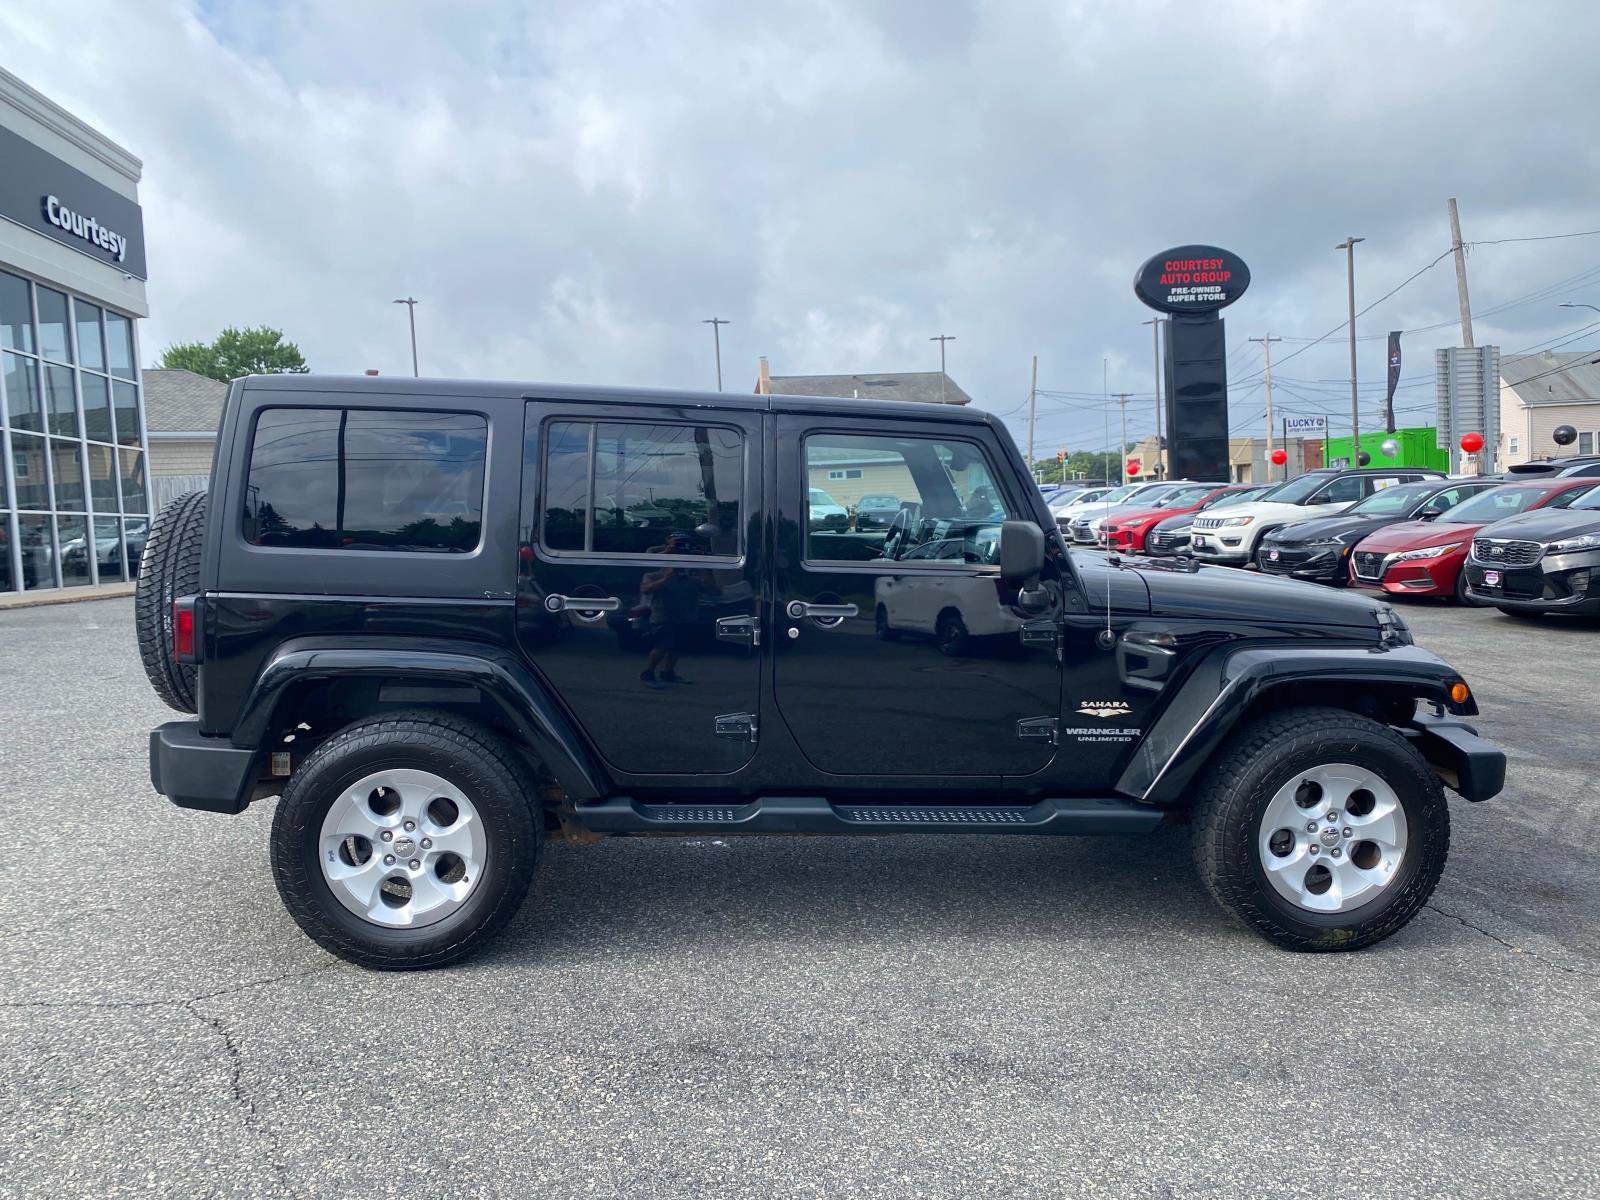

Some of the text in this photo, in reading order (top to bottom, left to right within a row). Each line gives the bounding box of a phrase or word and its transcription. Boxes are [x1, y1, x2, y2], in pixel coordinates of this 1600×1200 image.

[46, 194, 127, 262] Courtesy
[1165, 258, 1224, 272] COURTESY
[1160, 271, 1231, 284] AUTO GROUP
[1171, 285, 1222, 295] PRE-OWNED
[1167, 293, 1226, 302] SUPER STORE
[1287, 418, 1315, 428] LUCKY
[1065, 727, 1141, 736] WRANGLER
